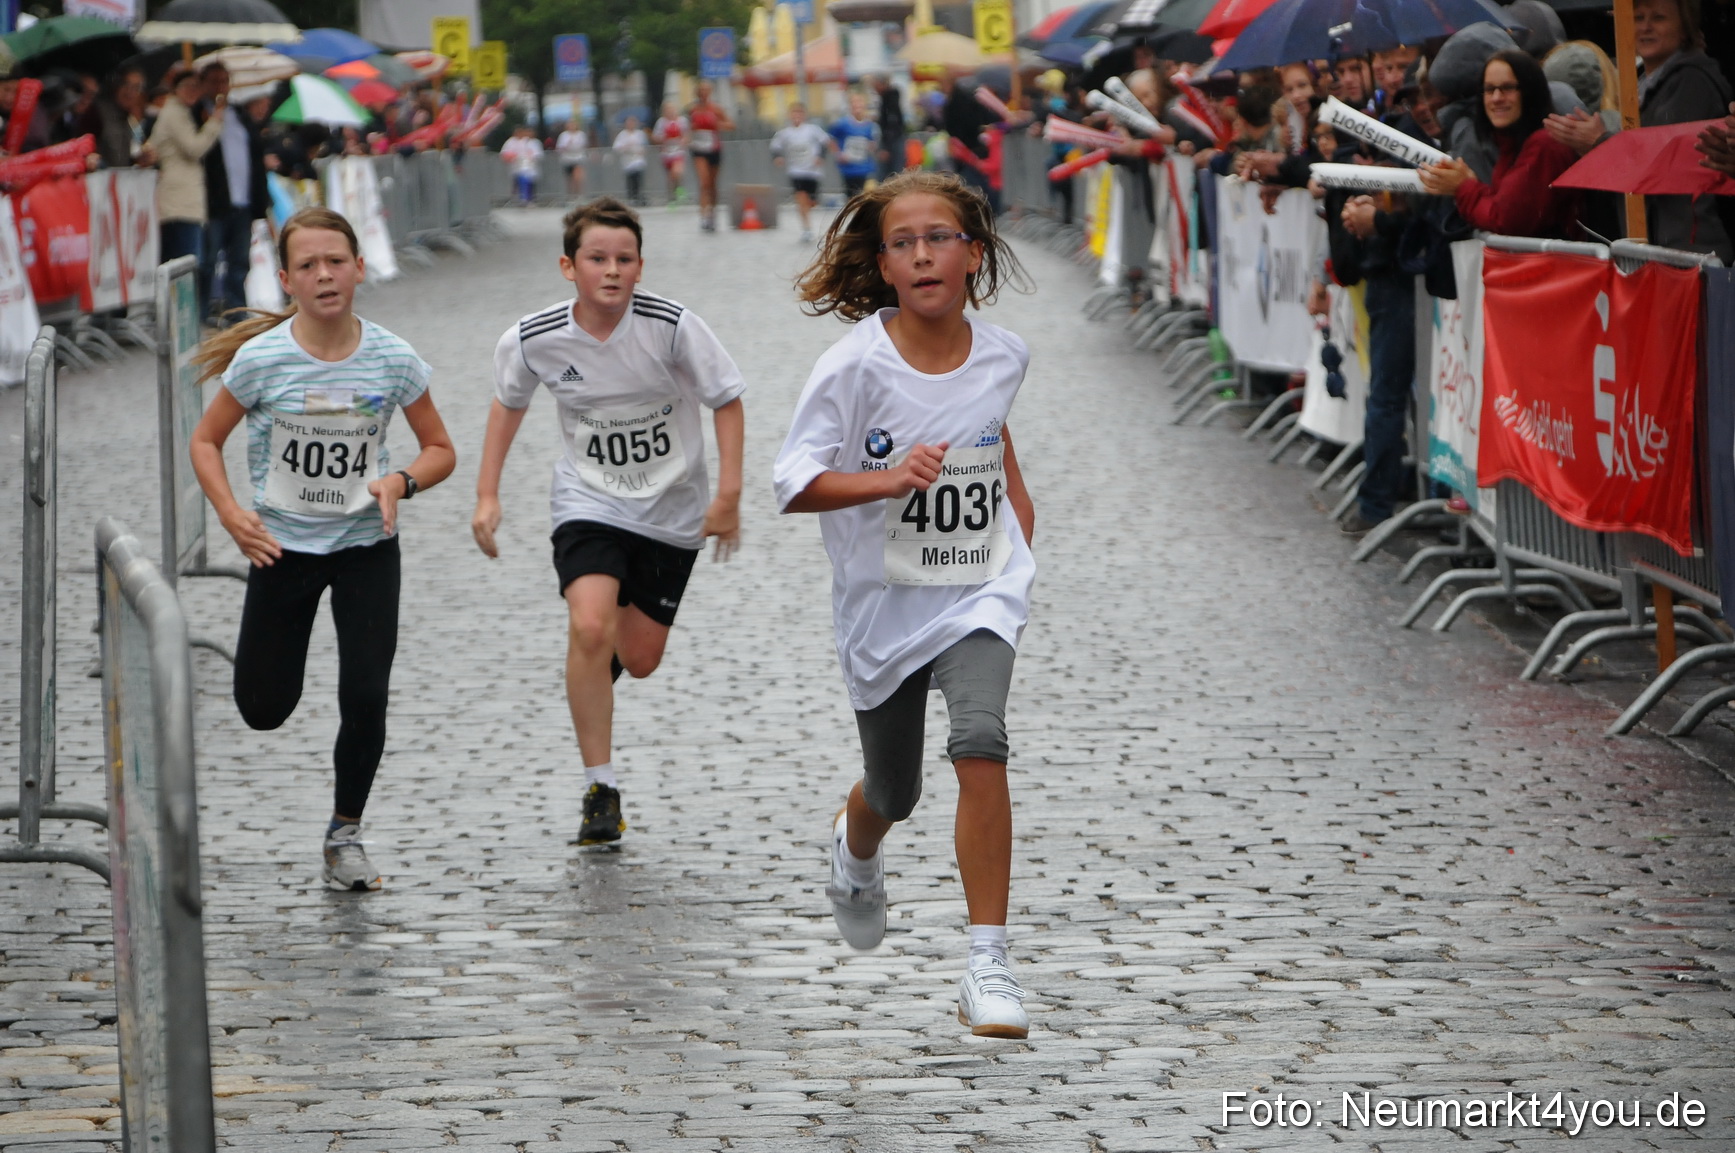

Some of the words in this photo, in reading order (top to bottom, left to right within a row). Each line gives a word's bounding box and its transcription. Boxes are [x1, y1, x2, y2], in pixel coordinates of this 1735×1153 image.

[274, 417, 309, 435] PARTL
[312, 426, 364, 437] Neumarkt
[580, 415, 608, 429] PARTL
[610, 411, 659, 427] Neumarkt
[587, 421, 671, 467] 4055
[281, 438, 368, 479] 4034
[942, 460, 998, 476] Neumarkt
[603, 471, 658, 492] PAUL
[299, 487, 345, 505] Judith
[901, 478, 1002, 533] 4036
